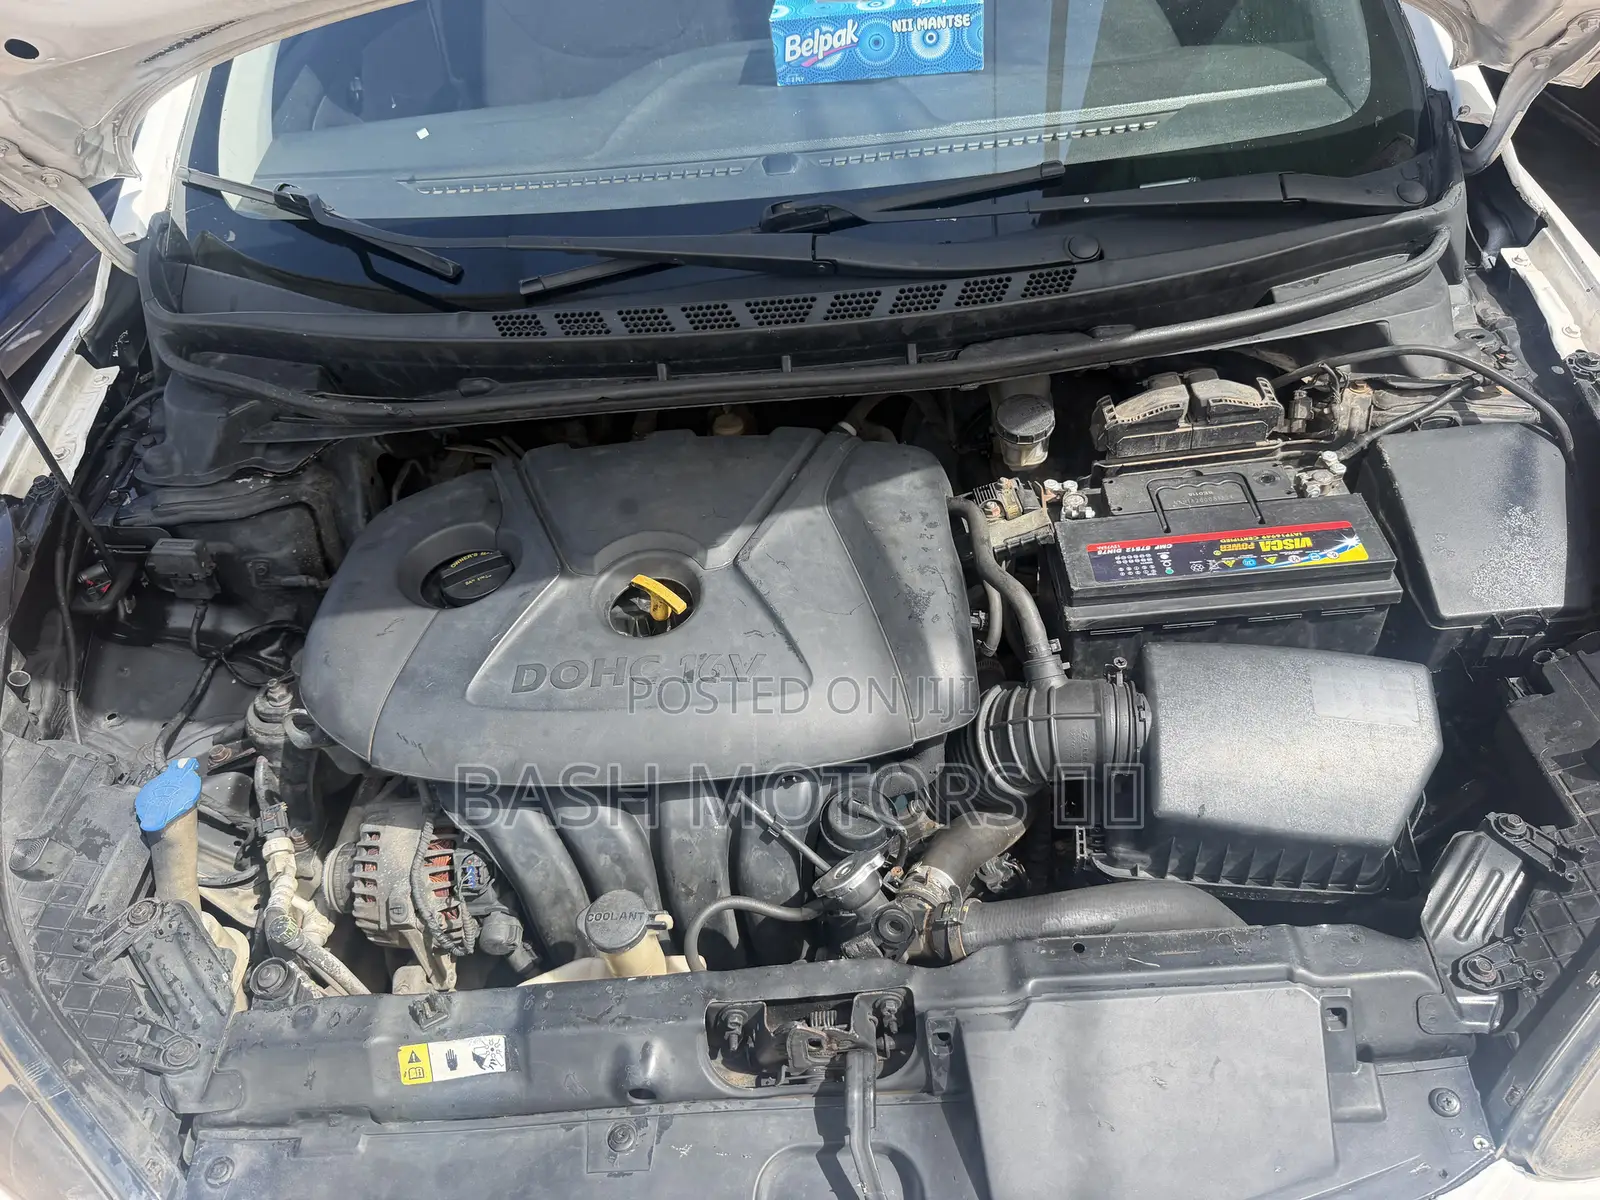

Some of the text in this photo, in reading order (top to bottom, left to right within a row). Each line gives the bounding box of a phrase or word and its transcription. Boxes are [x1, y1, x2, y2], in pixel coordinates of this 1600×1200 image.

[891, 13, 971, 33] NII MANTSE
[785, 18, 859, 62] Belpak
[1154, 543, 1173, 551] CMF
[1220, 537, 1313, 552] VISCA POWER
[511, 653, 767, 694] DOHC 16V
[586, 911, 645, 922] COOLANT
